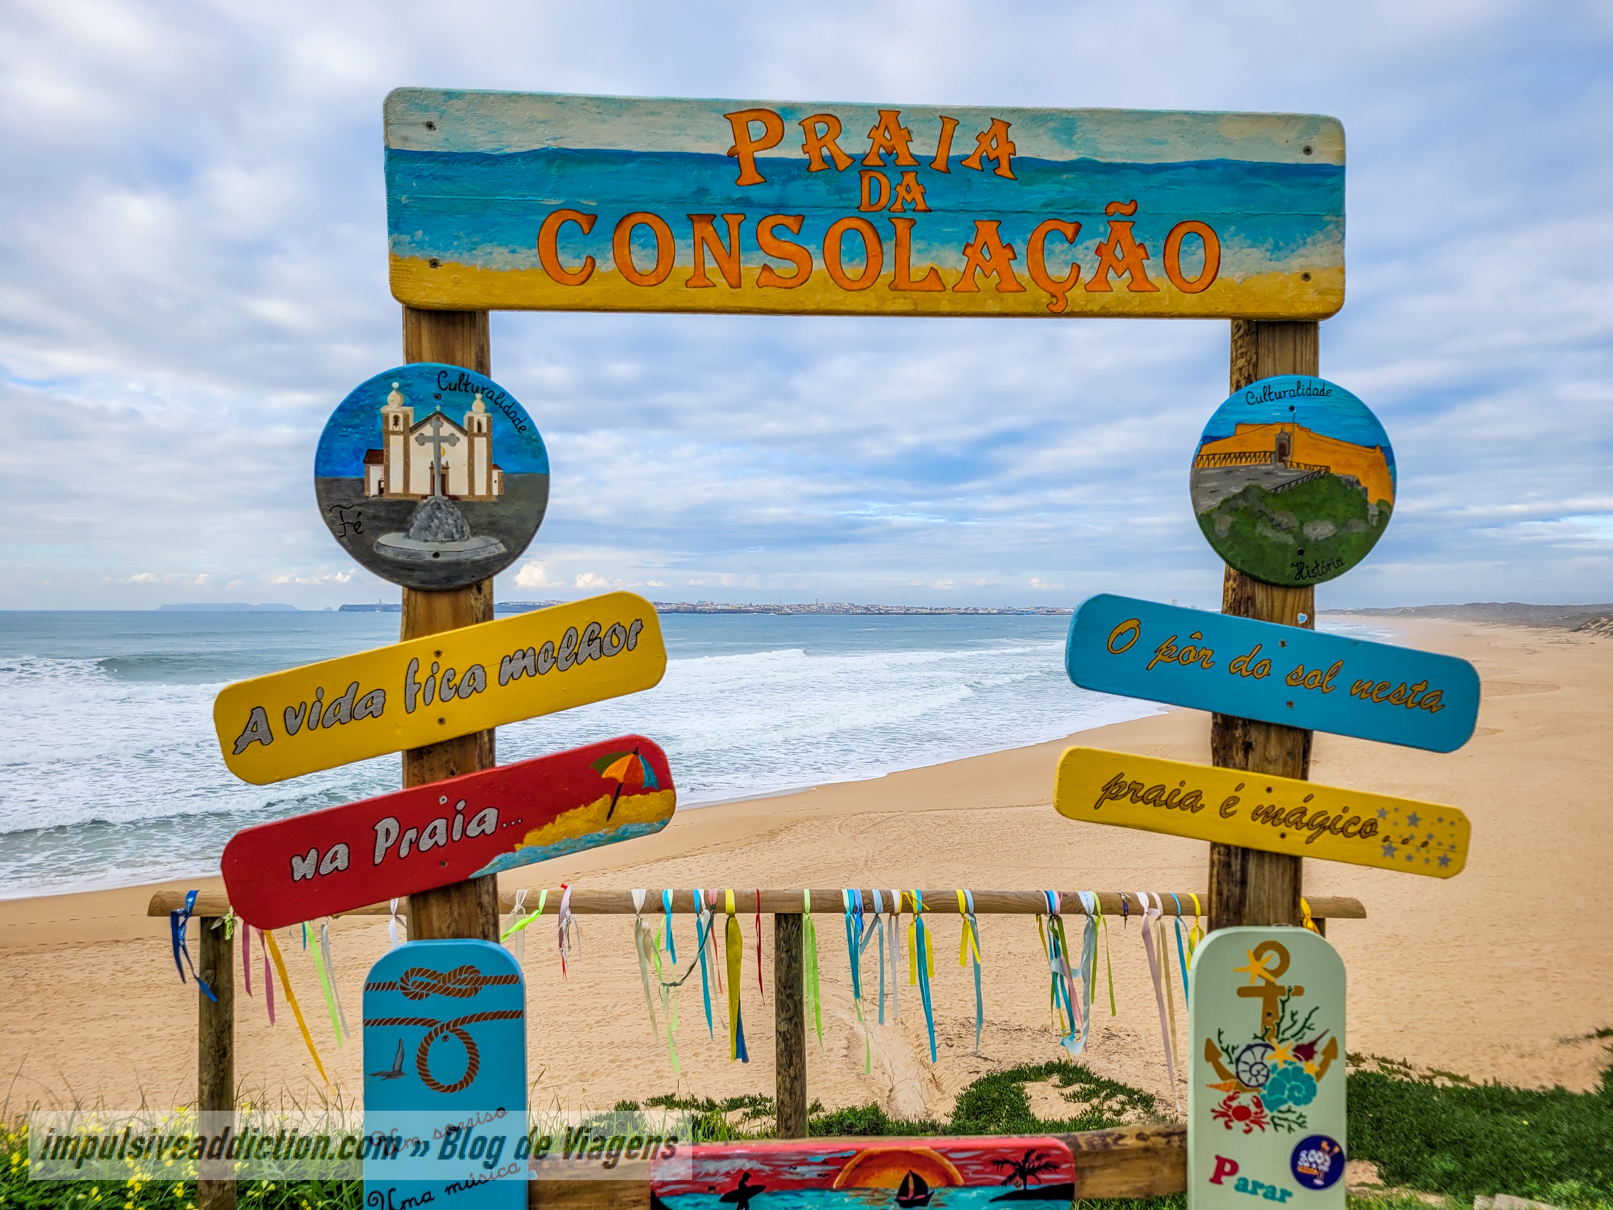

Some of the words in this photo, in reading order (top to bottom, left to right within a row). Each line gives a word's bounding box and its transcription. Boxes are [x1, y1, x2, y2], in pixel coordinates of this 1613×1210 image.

[724, 109, 1017, 186] PRAIA
[857, 170, 932, 213] DA
[537, 200, 1221, 313] CONSOLAÇÃO
[437, 371, 527, 434] Culturalidade
[1245, 381, 1333, 406] Culturalidade
[330, 504, 364, 538] Fé
[1290, 556, 1345, 581] História
[233, 706, 273, 755] A
[284, 681, 386, 736] vida
[404, 657, 487, 714] fica
[498, 618, 644, 687] melhor
[1106, 618, 1141, 655] O
[1146, 631, 1215, 671] pôr
[1228, 643, 1272, 680] do
[1285, 659, 1344, 694] sol
[1350, 678, 1446, 714] nesta
[1093, 771, 1206, 813] praia
[1218, 782, 1246, 819] é
[290, 842, 350, 882] na
[432, 1106, 509, 1141] sorriso
[444, 1162, 522, 1196] música
[1208, 1154, 1294, 1203] Parar
